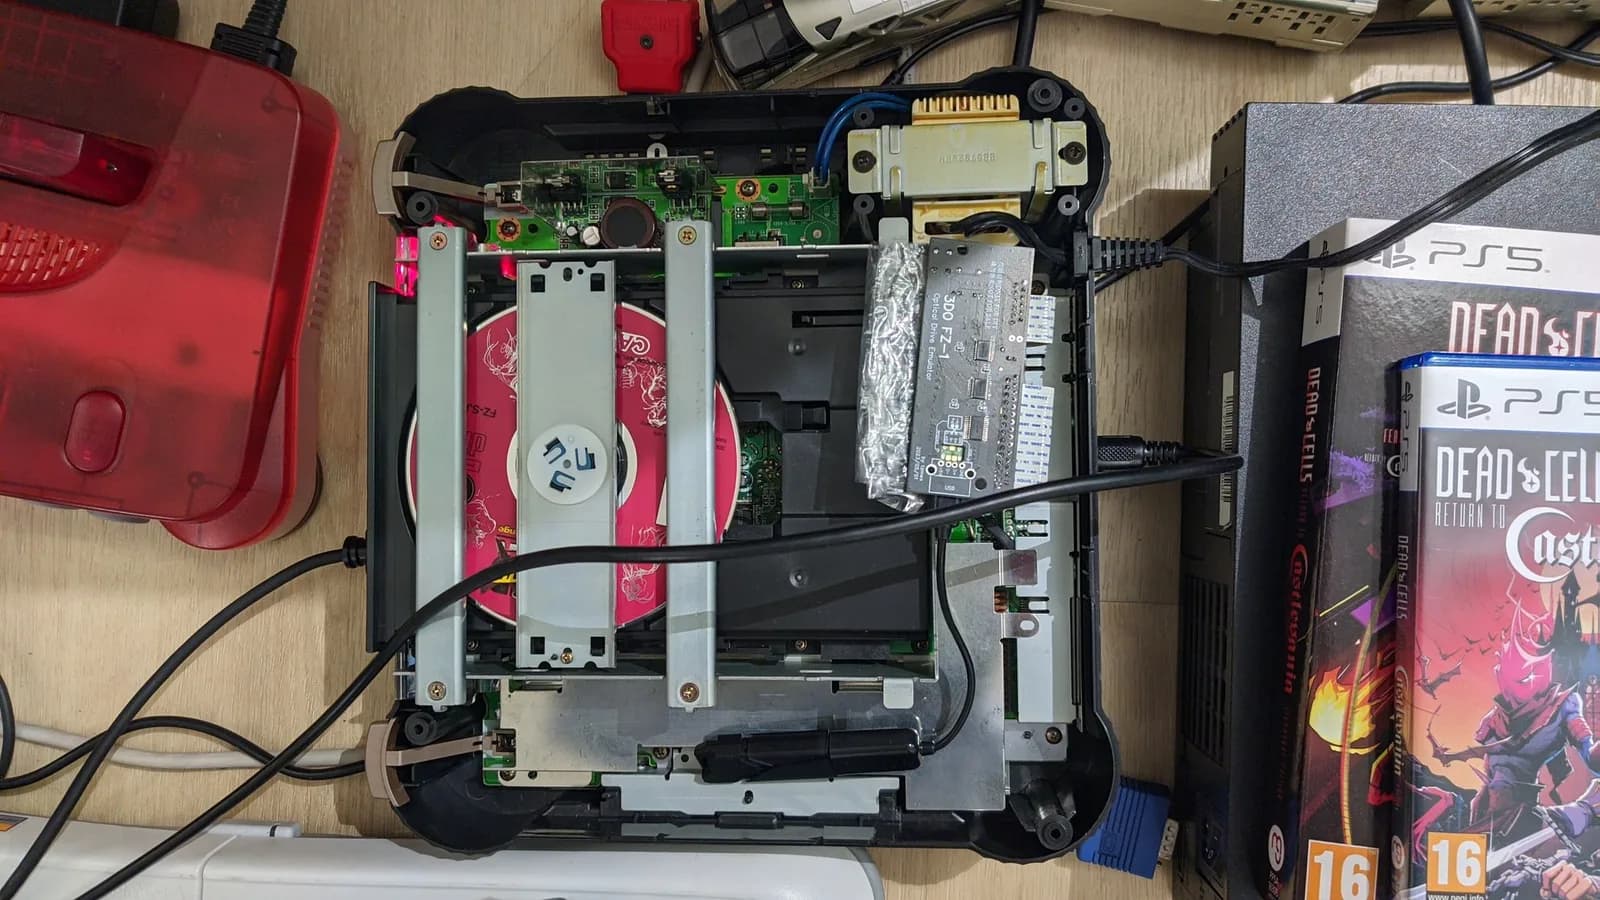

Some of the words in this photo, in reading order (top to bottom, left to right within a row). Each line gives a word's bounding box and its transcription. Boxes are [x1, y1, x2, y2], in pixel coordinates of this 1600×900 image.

[1428, 239, 1544, 273] PS5
[929, 293, 941, 319] Optical
[941, 294, 955, 321] 3DO
[927, 322, 938, 346] Drive
[938, 326, 952, 359] FZ-1
[1448, 300, 1540, 355] DEAD
[926, 346, 936, 381] Emulator
[1305, 366, 1321, 418] DEAD
[1300, 433, 1316, 484] CELLS
[1436, 445, 1514, 502] DEAD
[1435, 502, 1483, 528] RETURN
[1492, 503, 1506, 529] TO
[1398, 535, 1409, 571] DEAD
[1505, 506, 1600, 583] Cast
[1397, 584, 1408, 620] CELLS
[1313, 850, 1371, 900] 16
[1432, 839, 1482, 887] 16
